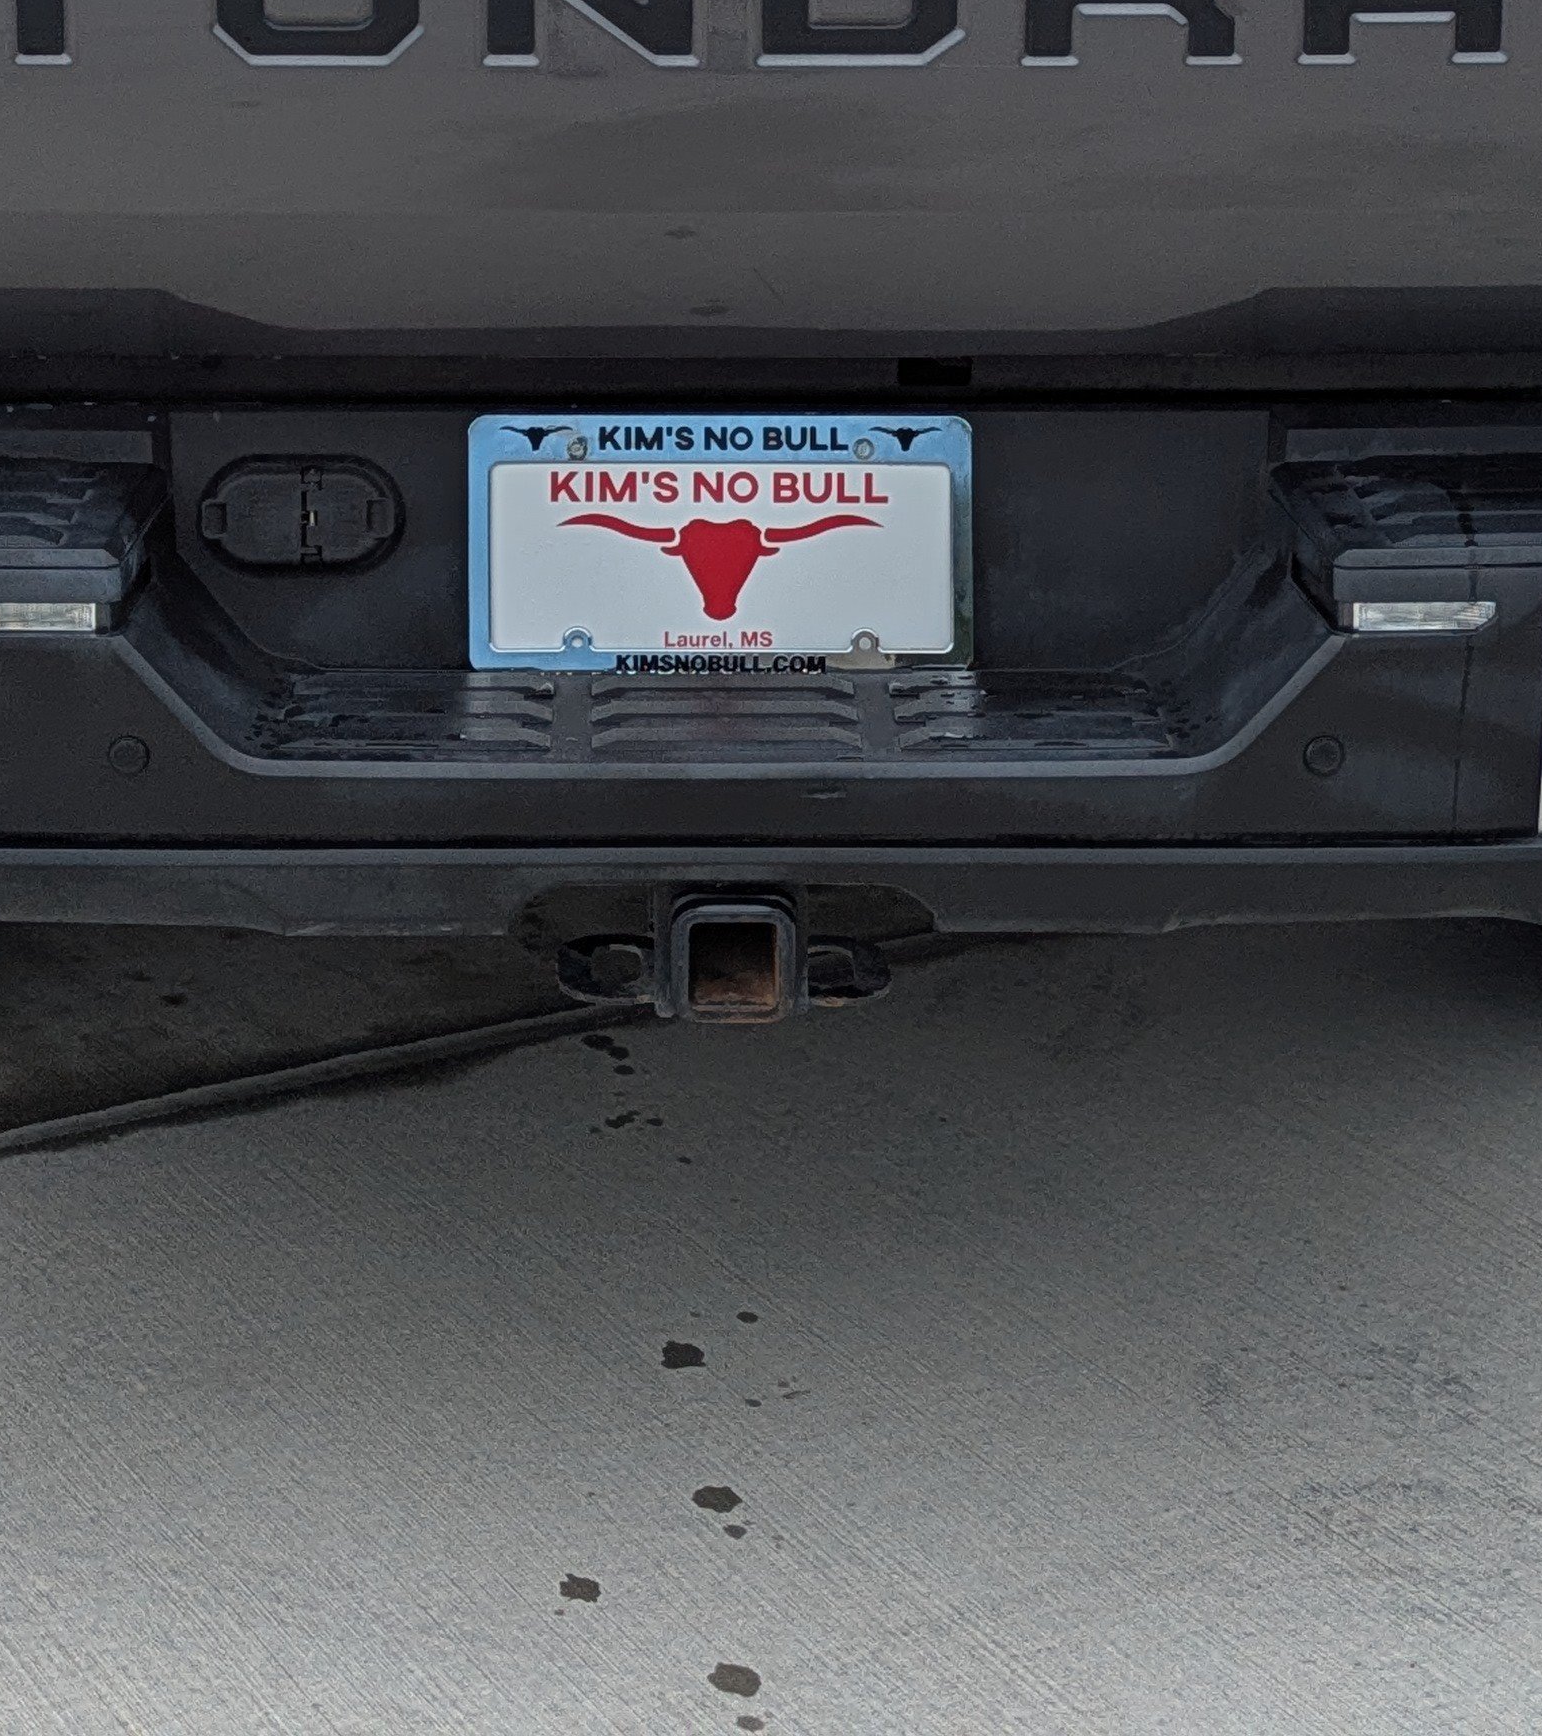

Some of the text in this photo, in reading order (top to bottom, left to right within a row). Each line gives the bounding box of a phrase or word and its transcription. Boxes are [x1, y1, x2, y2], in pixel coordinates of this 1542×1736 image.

[598, 426, 849, 451] KIM'S NO BULL
[549, 471, 889, 504] KIM'S NO BULL
[663, 631, 773, 649] Laurel, MS
[615, 654, 827, 674] KIMSNOBULL.COM
